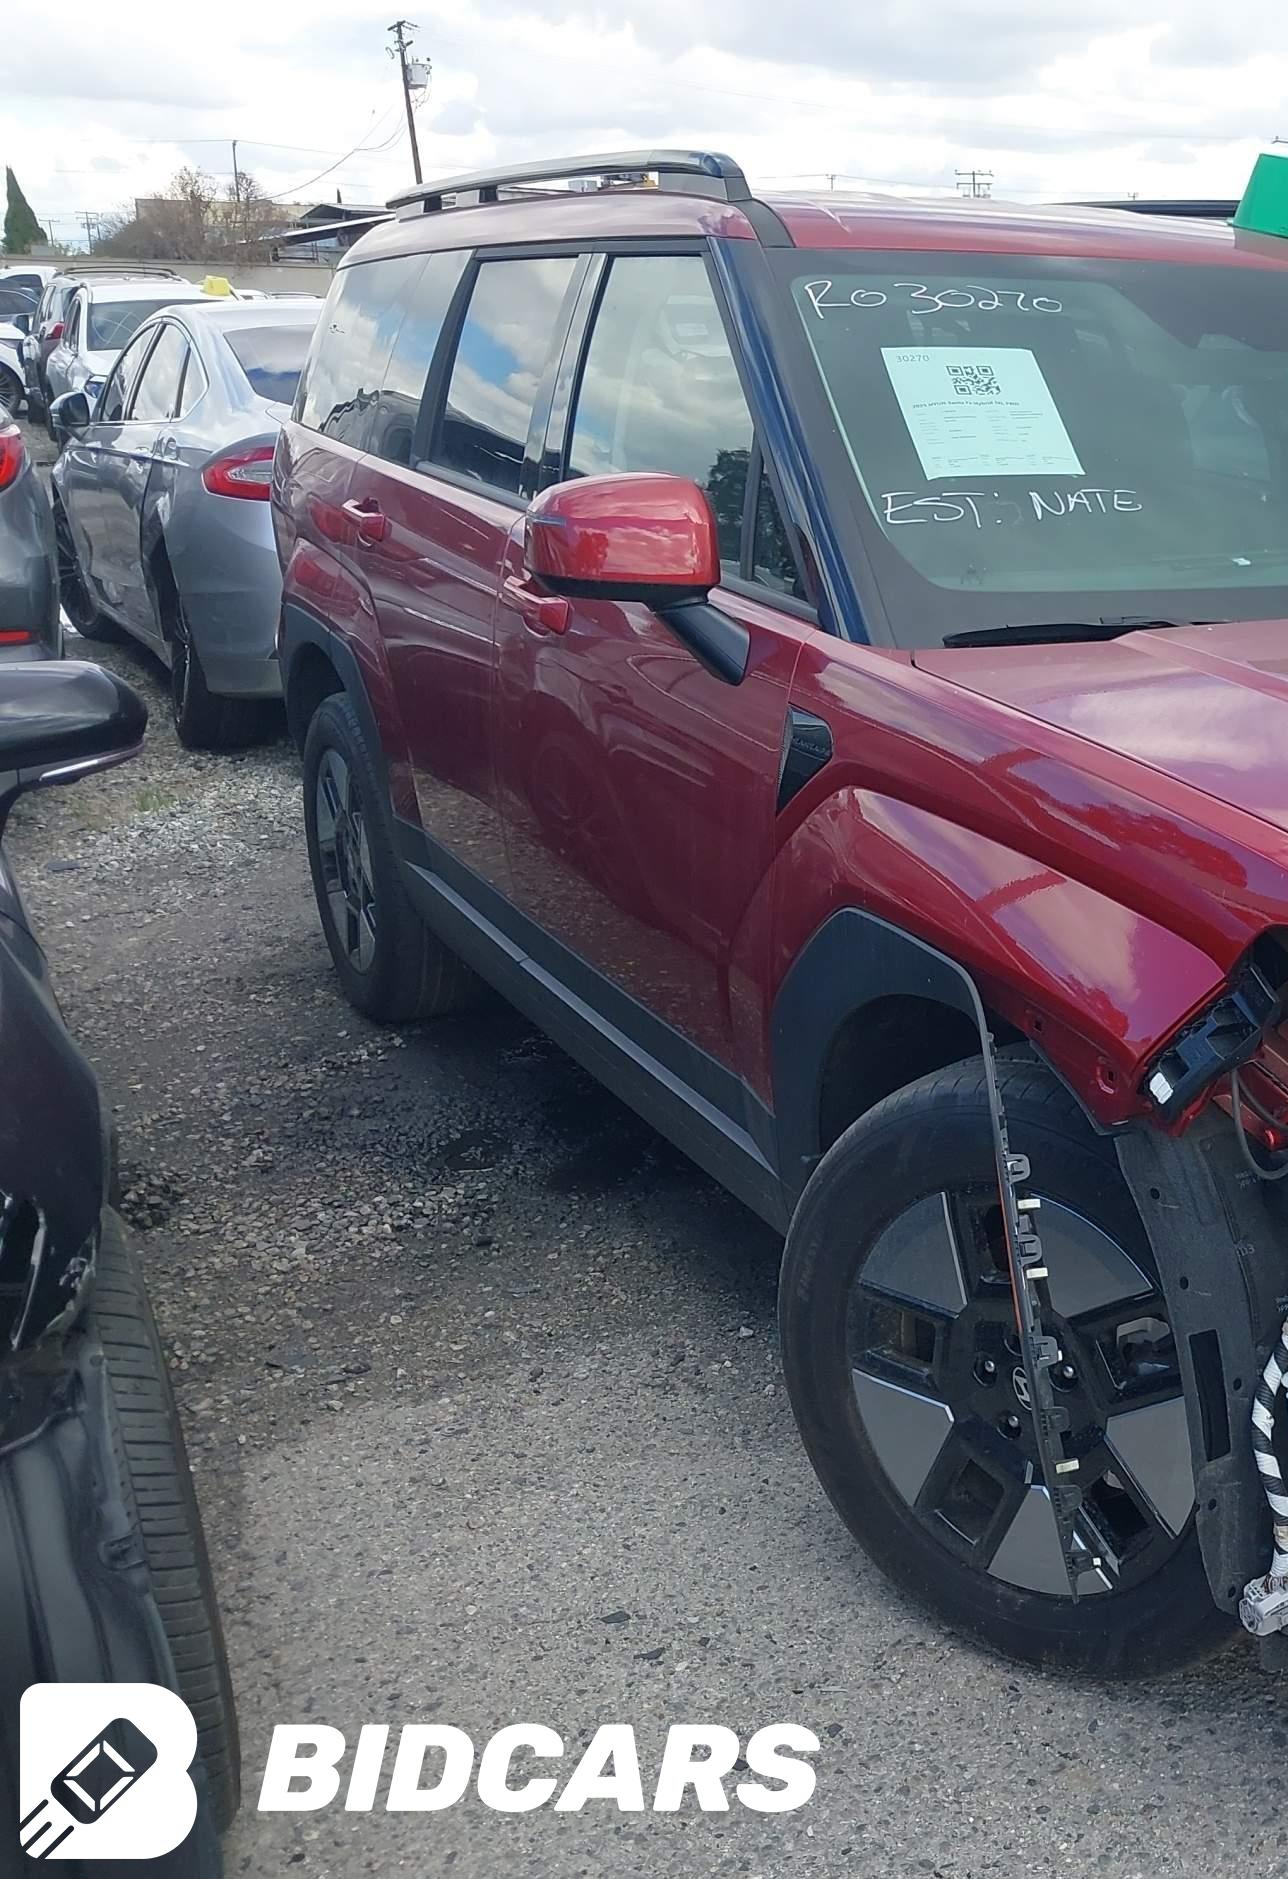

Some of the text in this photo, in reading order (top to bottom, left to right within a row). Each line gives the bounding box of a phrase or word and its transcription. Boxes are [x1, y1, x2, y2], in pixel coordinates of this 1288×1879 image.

[893, 283, 1063, 314] 30270
[896, 354, 930, 363] 30270
[1029, 488, 1143, 520] NATE
